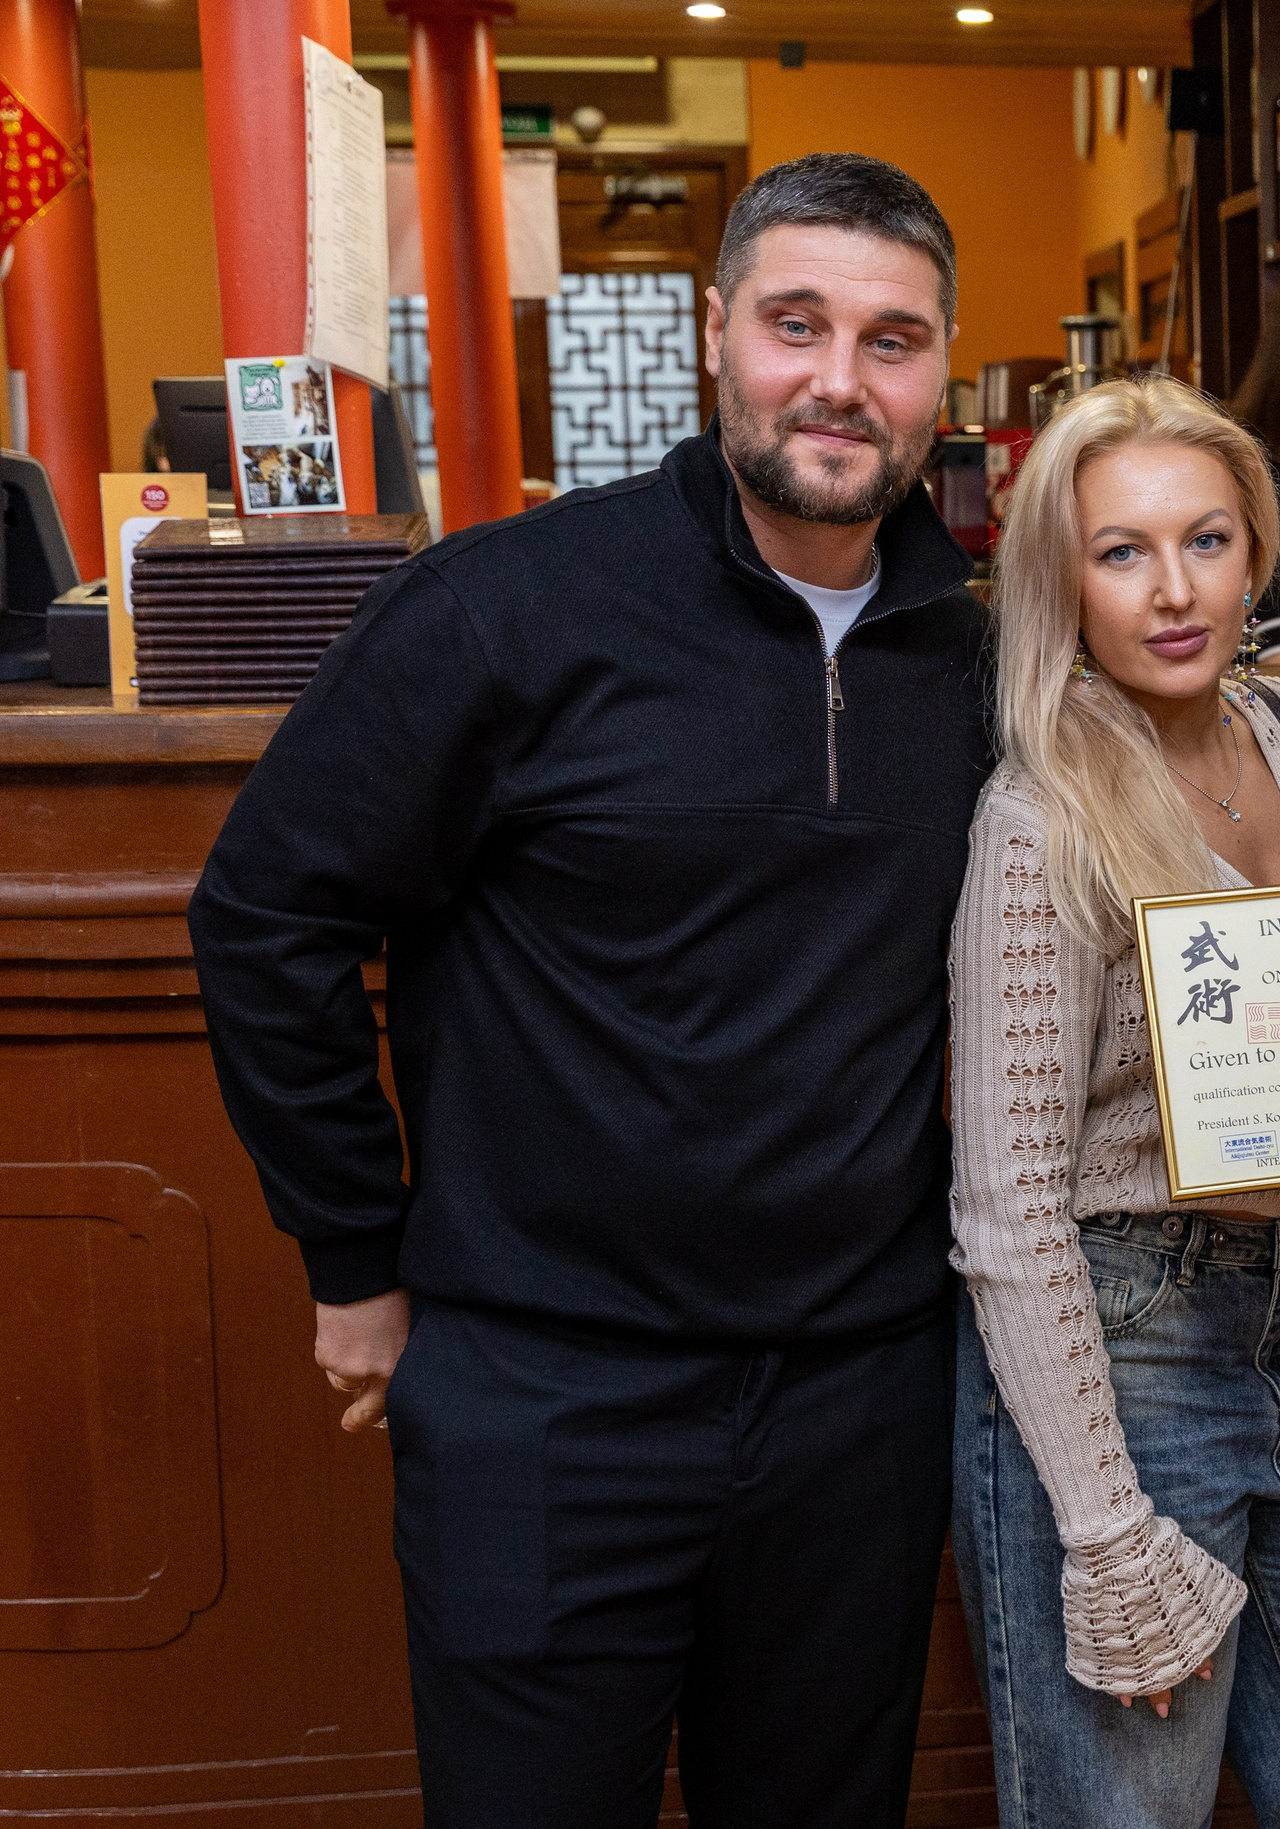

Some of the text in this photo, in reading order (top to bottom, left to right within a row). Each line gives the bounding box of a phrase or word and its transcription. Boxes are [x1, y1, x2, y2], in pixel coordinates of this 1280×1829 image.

[1177, 921, 1241, 1026] 武術
[1189, 1047, 1276, 1070] Given to
[1193, 1085, 1266, 1103] qualification
[1197, 1116, 1250, 1130] President
[1253, 1115, 1263, 1125] S.
